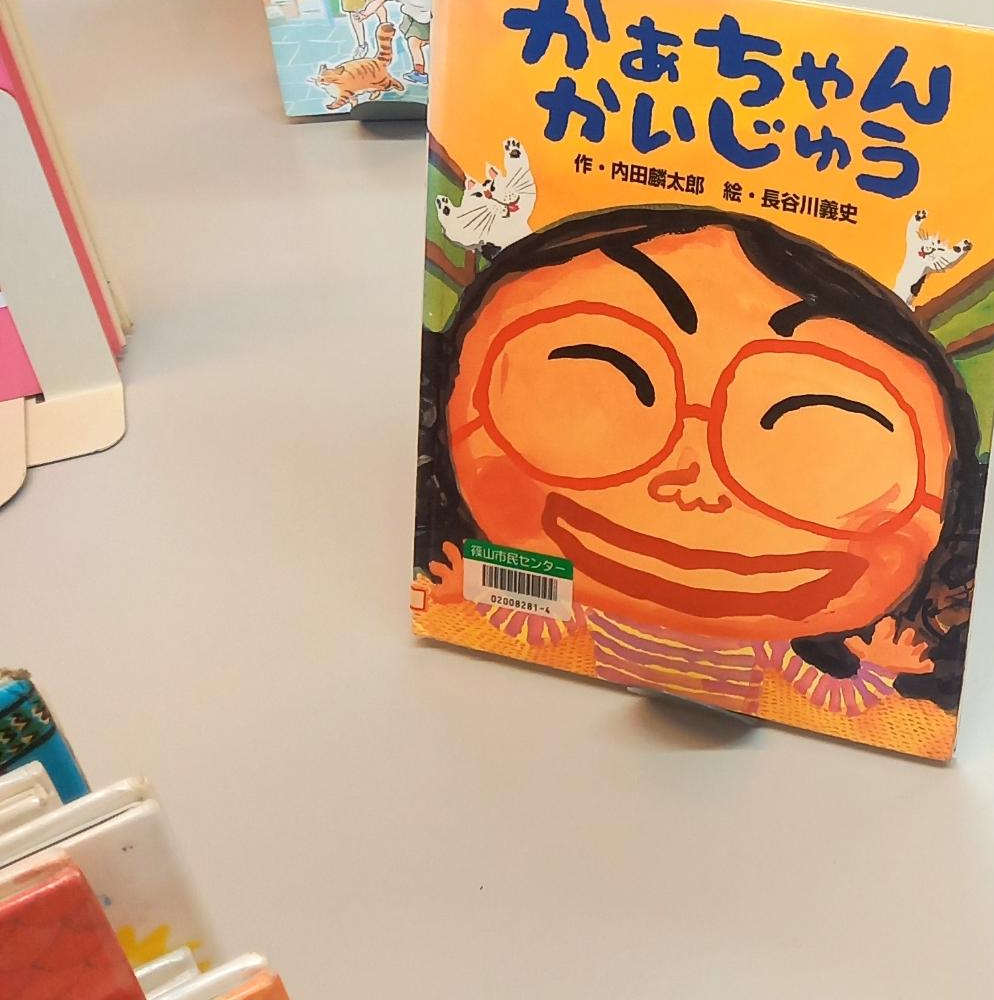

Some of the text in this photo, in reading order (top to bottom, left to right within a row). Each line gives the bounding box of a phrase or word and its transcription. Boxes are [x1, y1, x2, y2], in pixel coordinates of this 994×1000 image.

[535, 76, 920, 199] かいじゅう
[723, 181, 859, 225] 絵・長谷川義史
[471, 544, 566, 573] 篠山市民センター
[490, 594, 550, 615] 02008281-4
